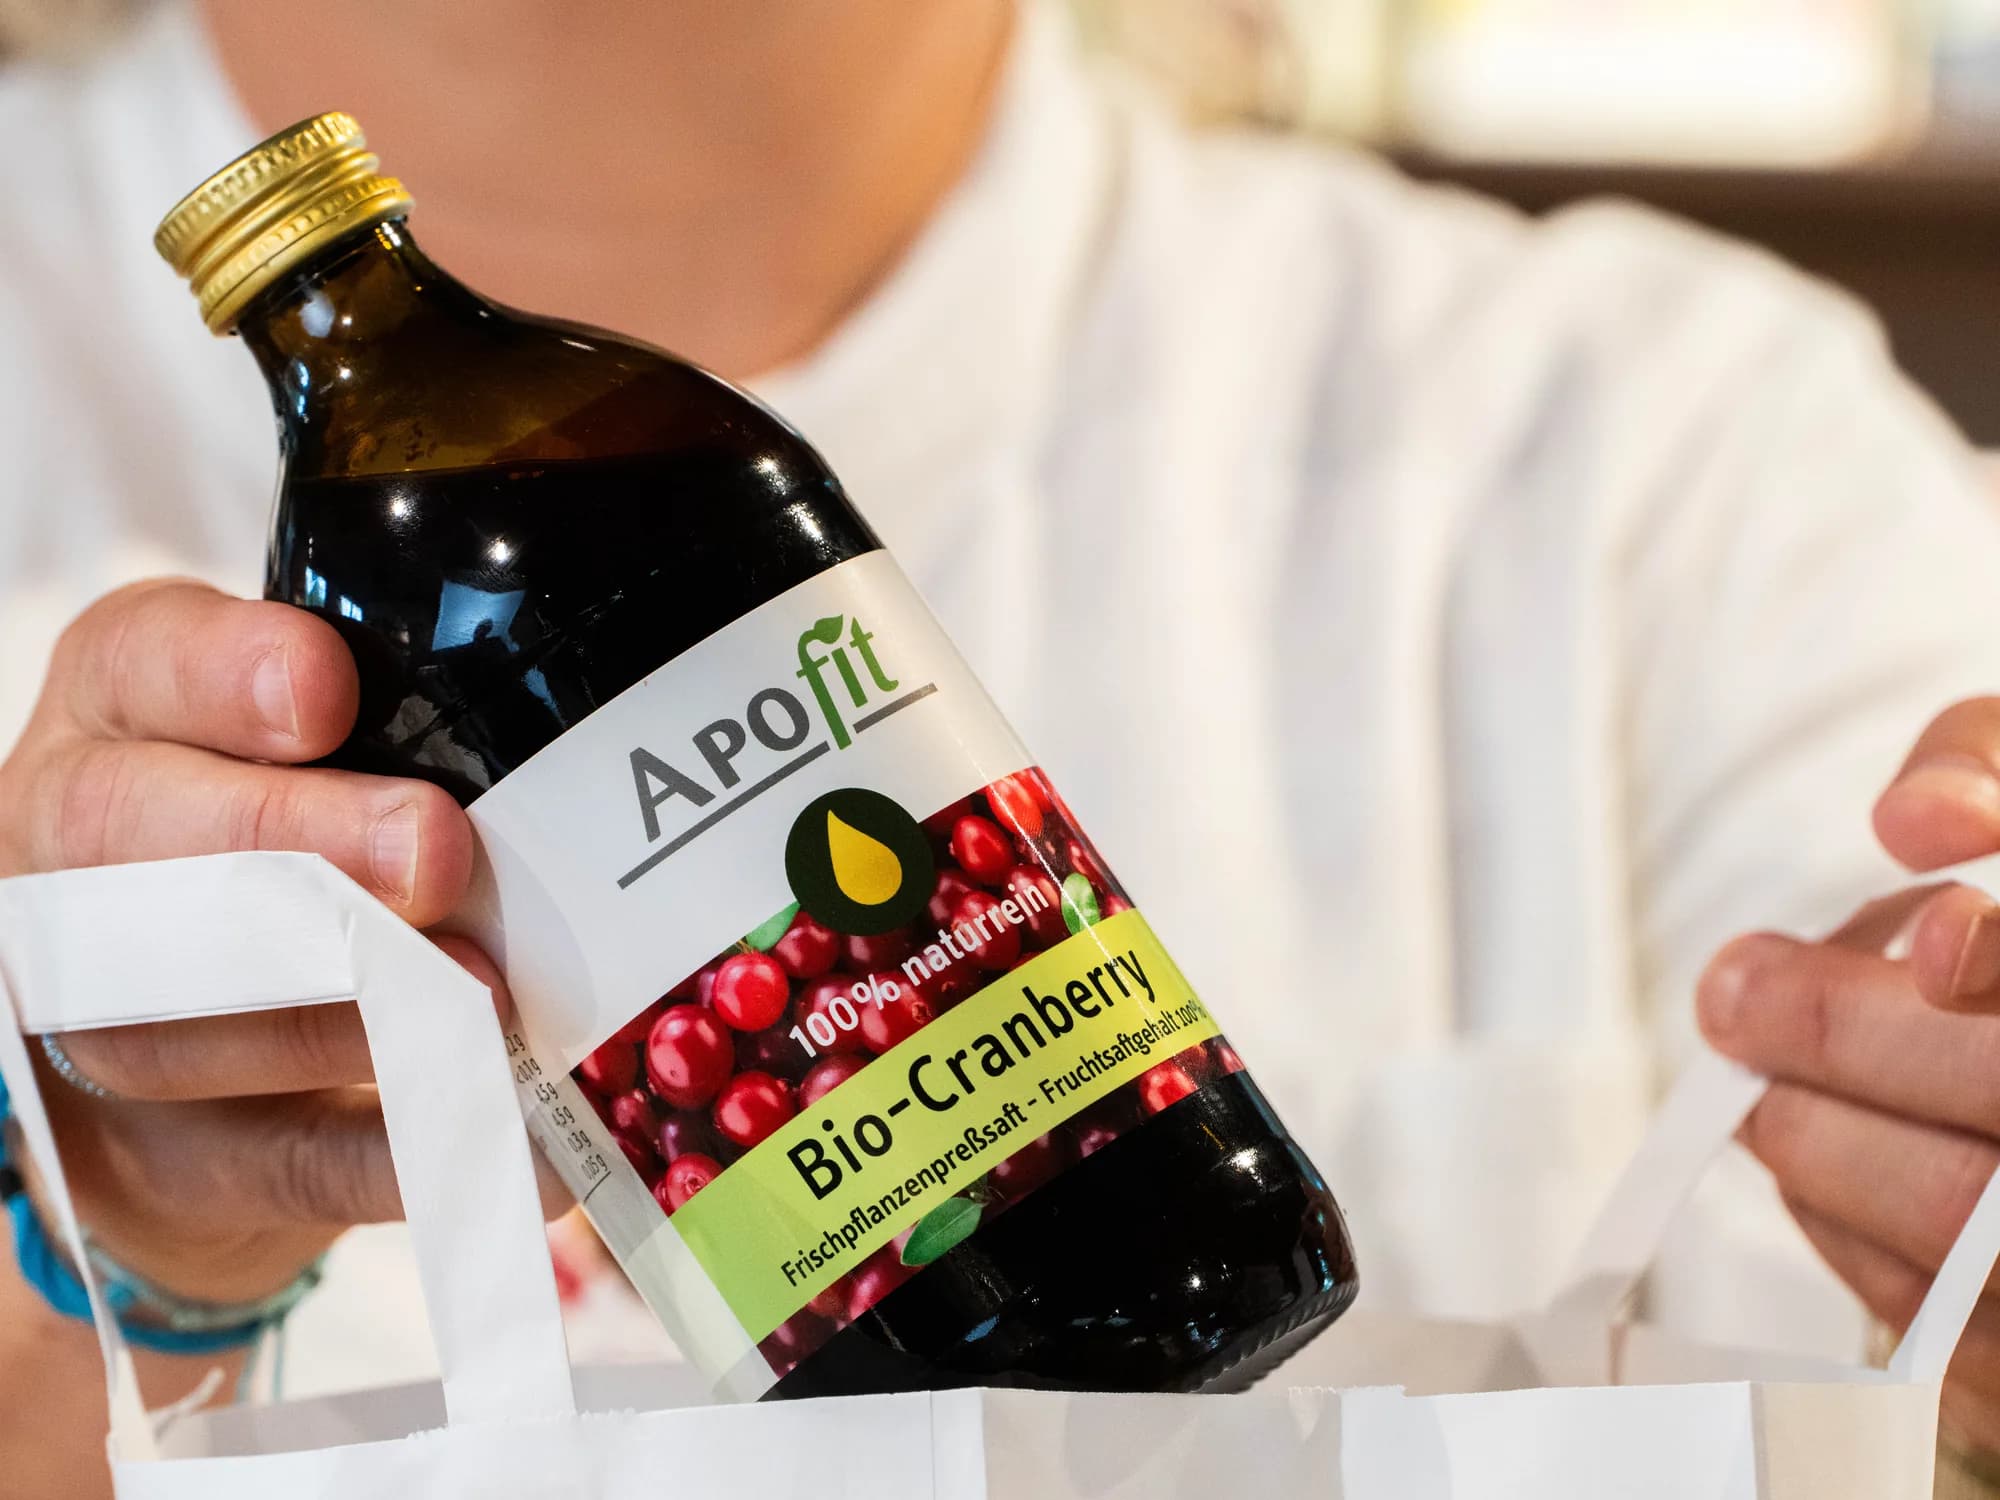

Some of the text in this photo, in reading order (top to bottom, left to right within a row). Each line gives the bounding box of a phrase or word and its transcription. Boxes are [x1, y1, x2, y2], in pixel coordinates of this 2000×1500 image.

[787, 949, 1156, 1200] Bio-Cranberry
[789, 882, 1050, 1058] 100% naturrein
[781, 1100, 1028, 1286] Frischpflanzenpreßsaft
[1038, 1010, 1181, 1104] Fruchtsaftgehalt
